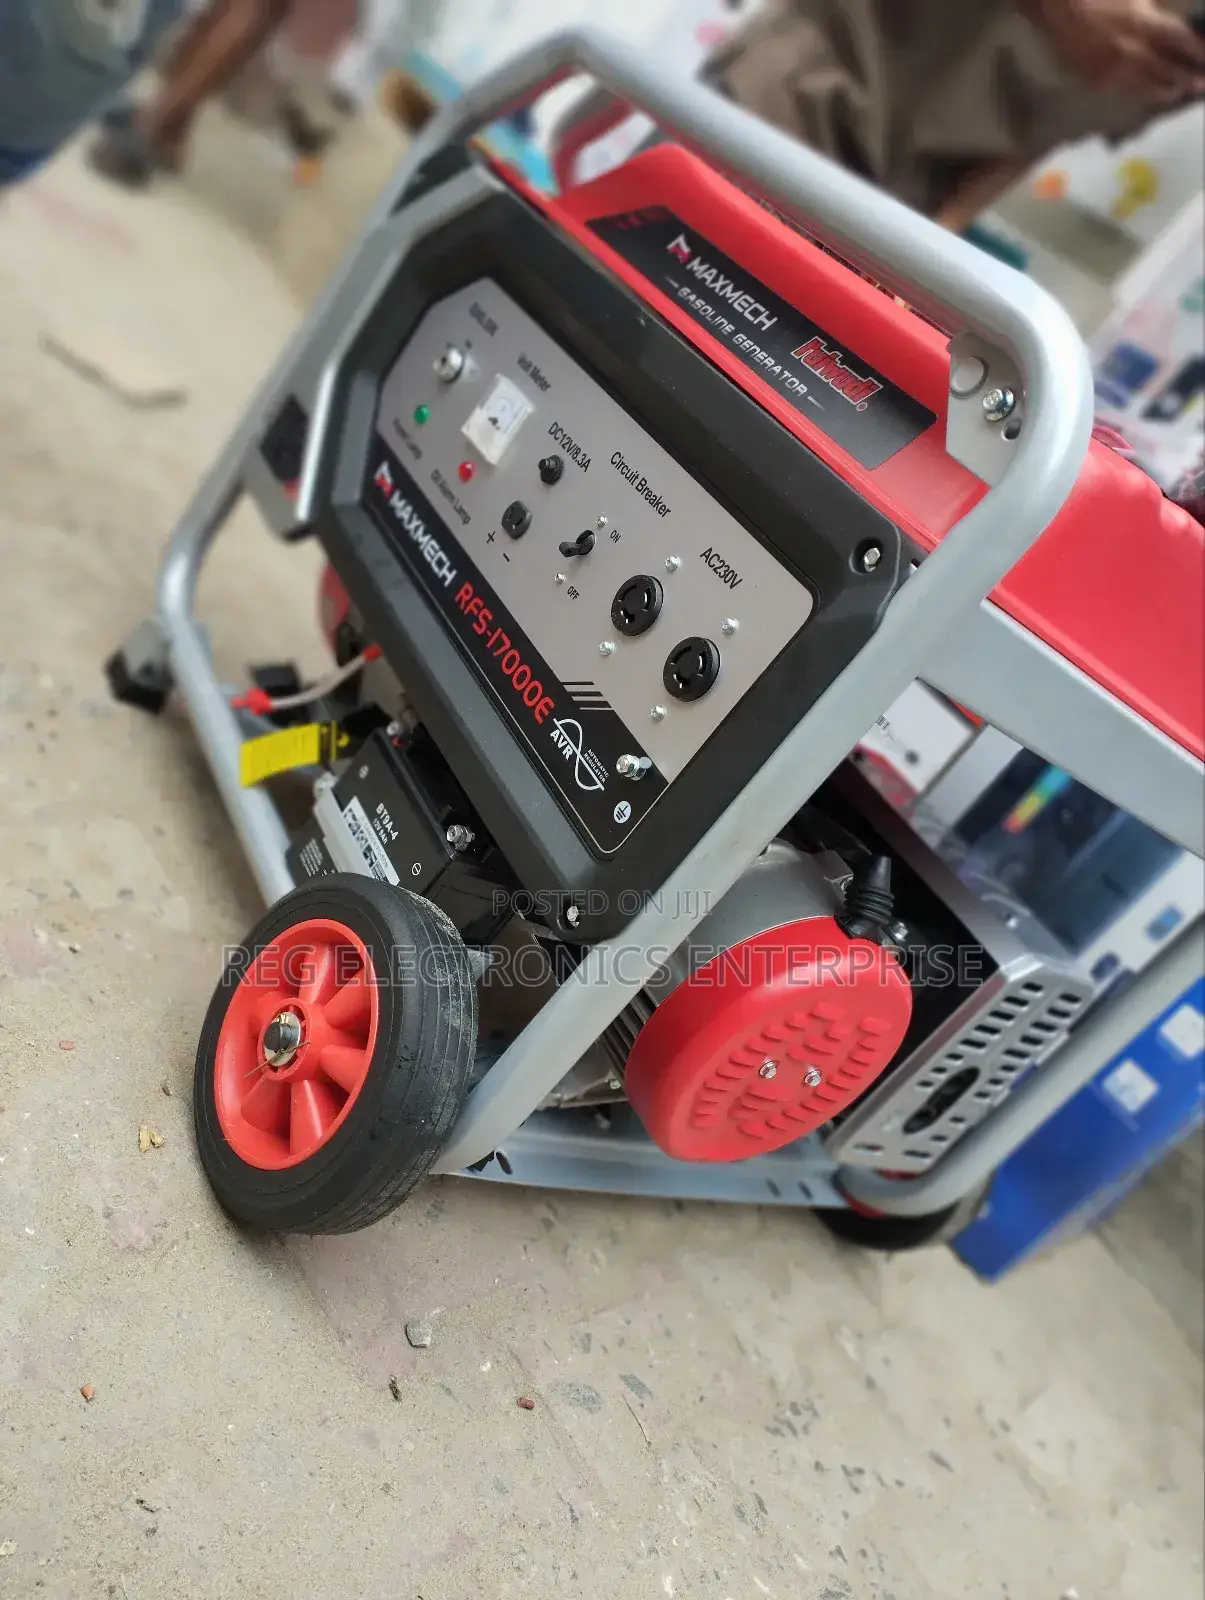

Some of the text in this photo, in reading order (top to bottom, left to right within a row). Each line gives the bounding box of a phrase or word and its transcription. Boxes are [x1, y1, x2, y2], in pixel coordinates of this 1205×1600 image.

[686, 256, 778, 332] MAXMECH
[678, 287, 808, 398] GASOLINE GENERATOR
[529, 362, 551, 393] Meter
[548, 421, 592, 473] DC12V/8.3A
[610, 451, 671, 518] Circuit Breaker
[610, 530, 622, 543] ON
[699, 547, 743, 590] AC230V
[388, 490, 556, 724] MAXMECH RFS-17000E
[567, 586, 580, 600] OFF
[550, 729, 573, 760] AVR
[588, 749, 610, 778] AUTOMATIC
[583, 753, 606, 783] REGULATOR
[376, 802, 399, 840] BT9A-4
